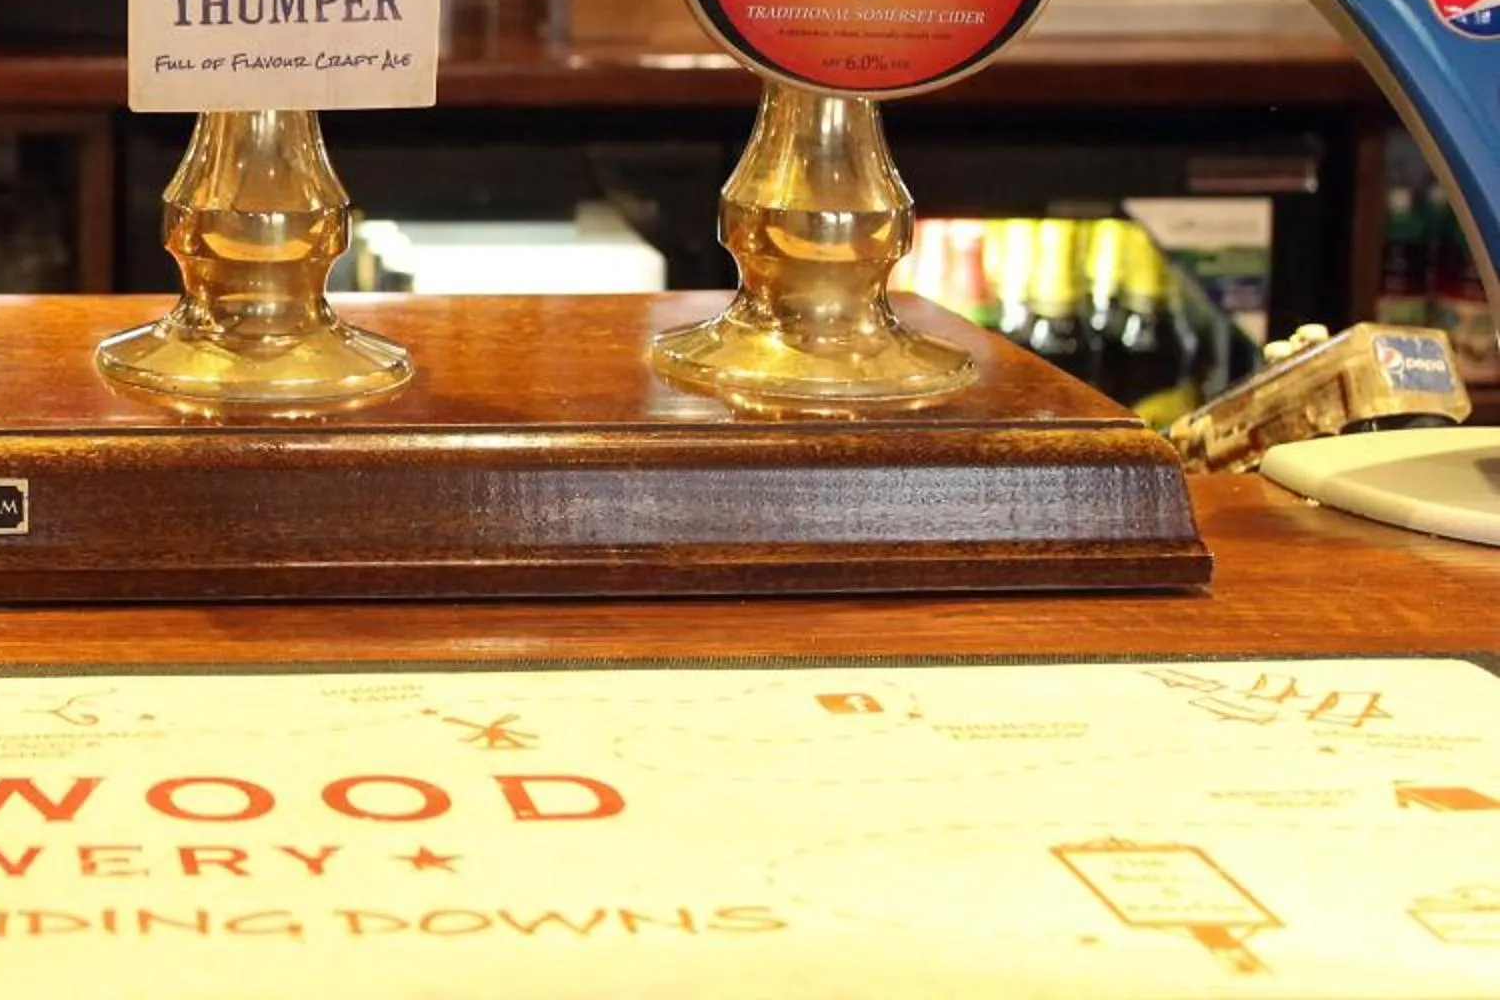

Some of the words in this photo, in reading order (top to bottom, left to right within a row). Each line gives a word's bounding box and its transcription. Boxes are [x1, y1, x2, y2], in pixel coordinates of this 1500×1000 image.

[746, 5, 850, 21] TRADITIONAL
[855, 7, 934, 23] SOMERSET
[938, 10, 986, 25] CIDER
[333, 906, 788, 936] DOWNS
